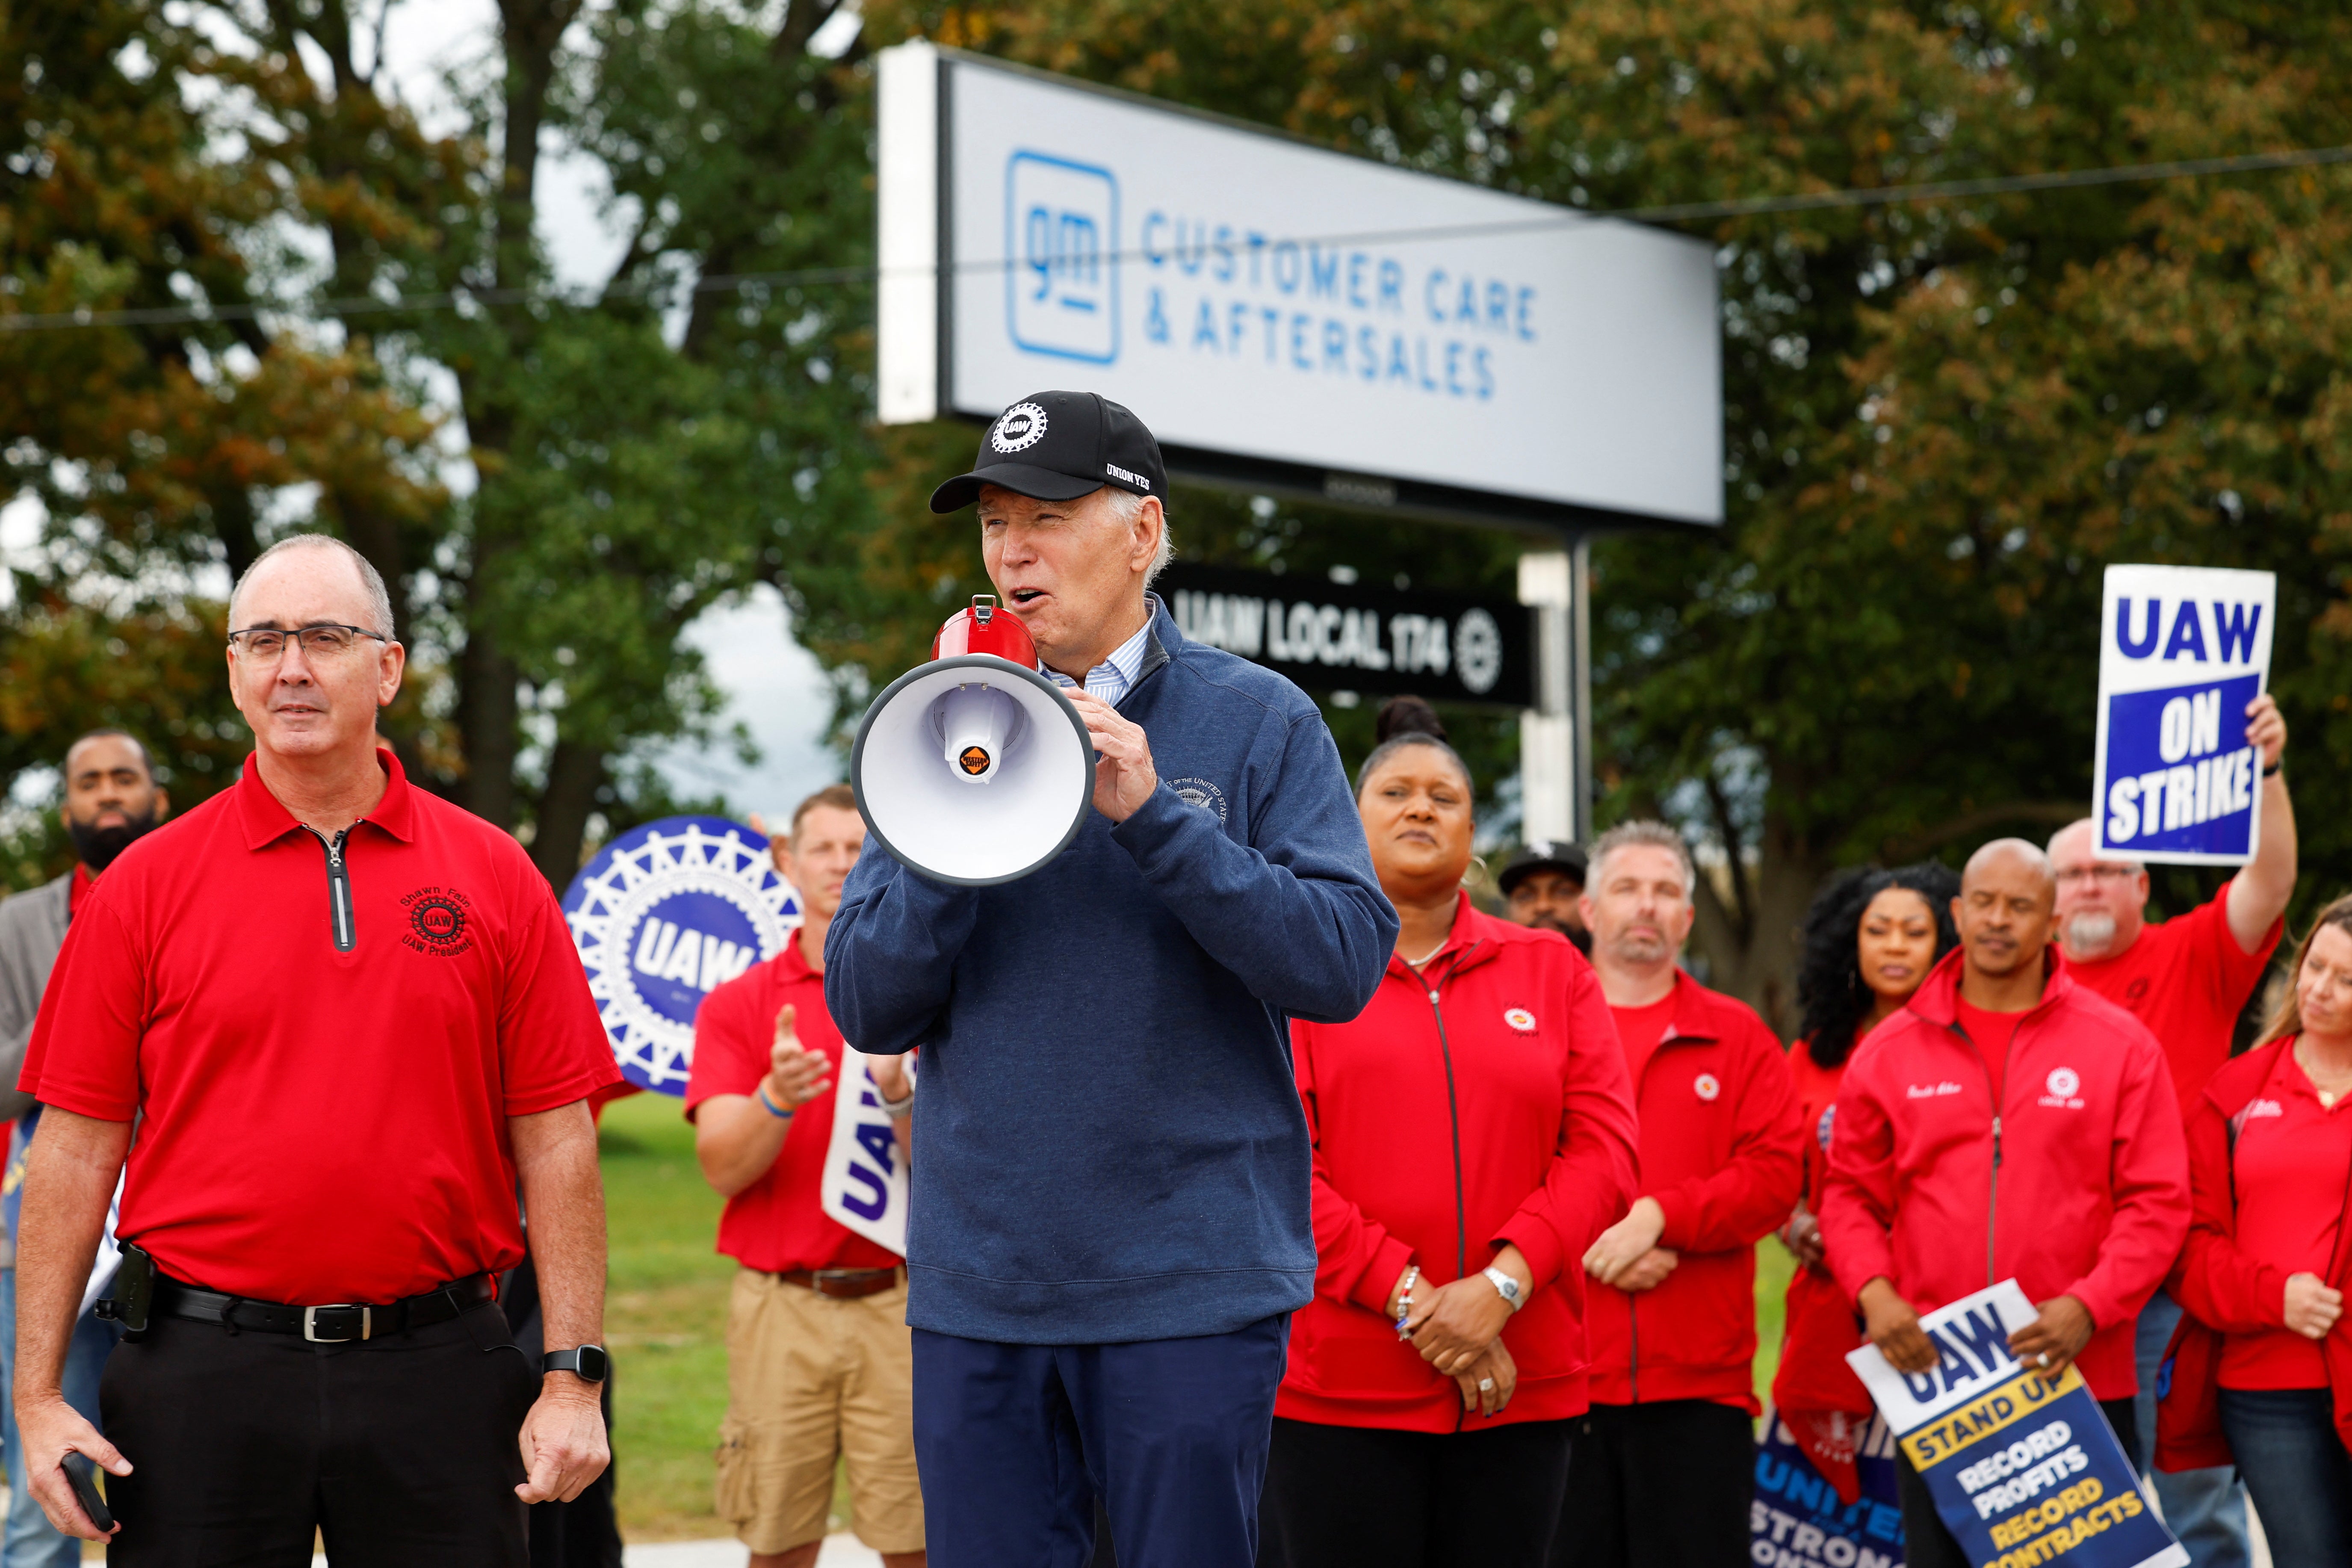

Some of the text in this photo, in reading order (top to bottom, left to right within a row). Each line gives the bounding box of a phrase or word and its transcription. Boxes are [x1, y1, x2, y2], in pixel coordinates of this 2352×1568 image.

[1028, 206, 1099, 301] gm
[1141, 210, 1537, 342] CUSTOMER CARE
[1144, 287, 1496, 402] & AFTERSALES
[1005, 420, 1031, 434] UAW
[1107, 463, 1150, 490] UNION YES
[1173, 588, 1265, 659] UAW
[1267, 598, 1390, 671] LOCAL
[1389, 612, 1449, 676] 174
[2116, 597, 2262, 665] UAW
[2159, 688, 2221, 764] ON
[1194, 777, 1221, 796] UNITED
[2107, 745, 2253, 844] STRIKE
[400, 886, 440, 907] Shawn
[425, 915, 452, 927] UAW
[402, 934, 472, 957] UAW President
[634, 916, 756, 993] UAW
[1916, 1396, 2014, 1460] STAND
[1956, 1420, 2072, 1494] RECORD
[1755, 1451, 1906, 1546] UNITE
[1971, 1444, 2089, 1521] PROFITS
[1989, 1476, 2104, 1551] RECORD
[1750, 1499, 1907, 1568] STRON
